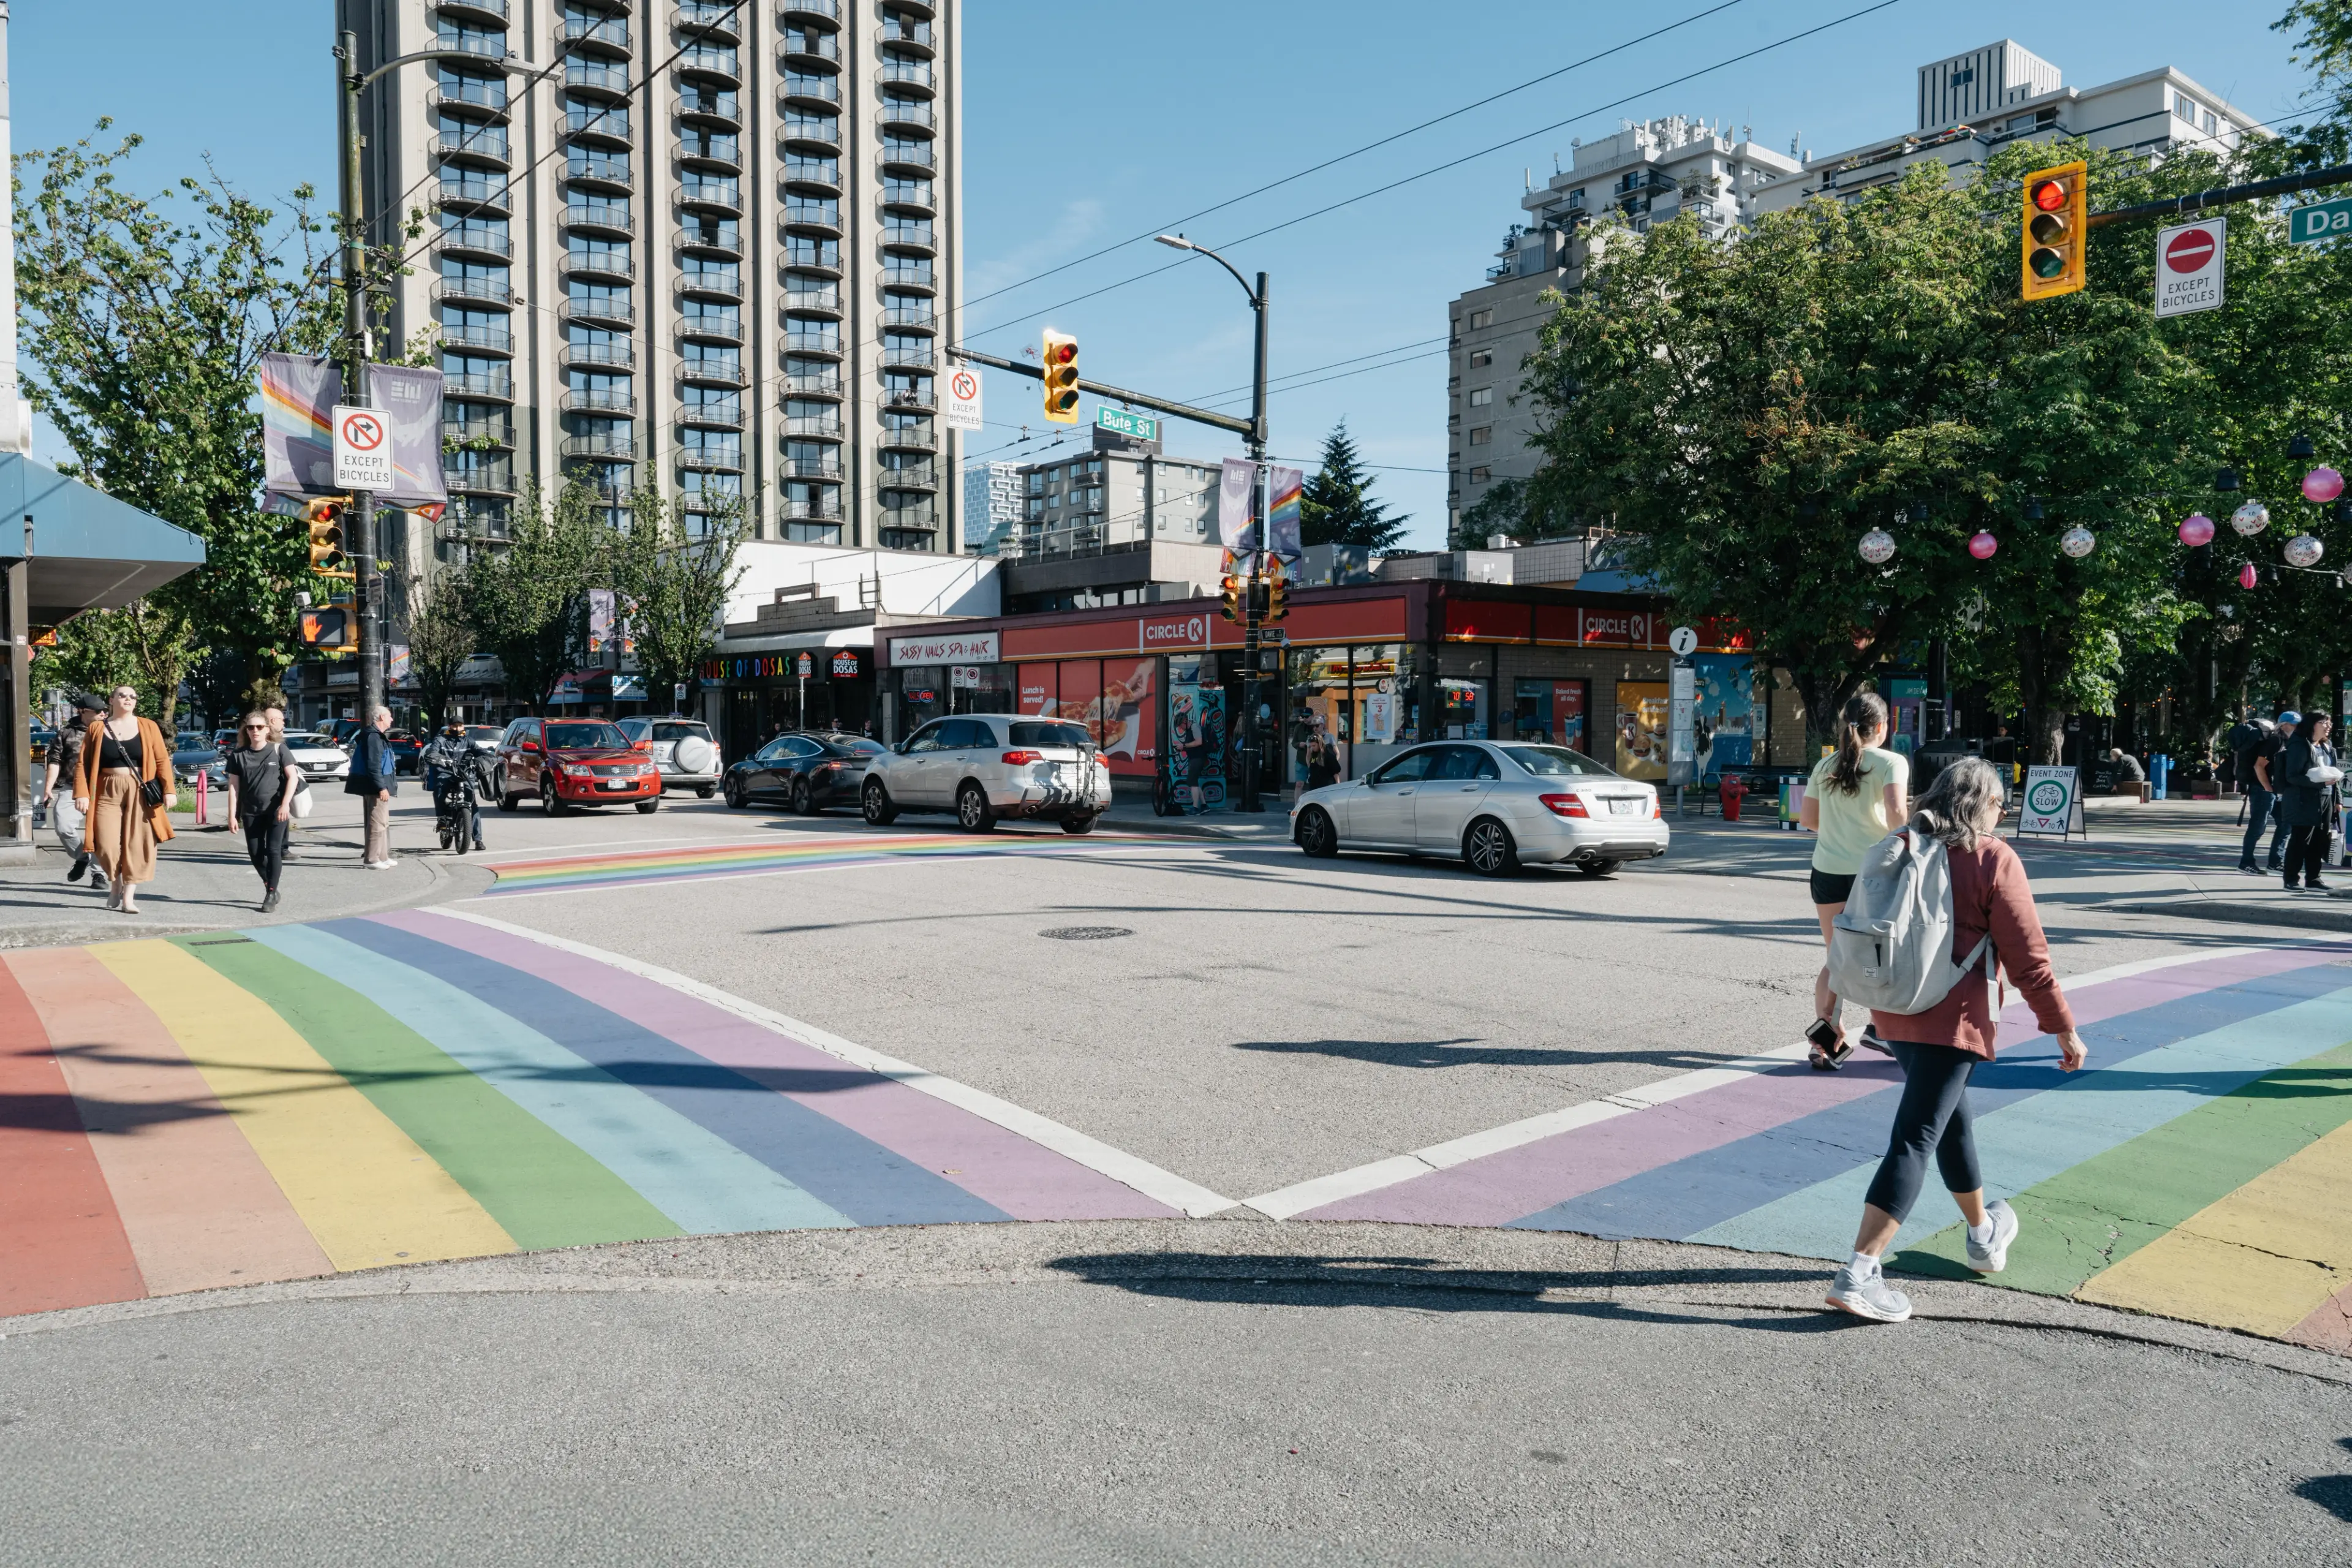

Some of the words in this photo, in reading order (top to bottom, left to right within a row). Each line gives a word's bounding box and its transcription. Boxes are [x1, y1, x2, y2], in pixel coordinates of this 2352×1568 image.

[2168, 277, 2211, 294] EXCEPT
[2163, 290, 2215, 308] BICYCLES
[952, 403, 976, 413] EXCEPT
[949, 414, 980, 425] BICYCLES
[1103, 411, 1131, 432] Bute
[1137, 420, 1150, 436] St
[344, 455, 383, 467] EXCEPT
[340, 470, 389, 483] BICYCLES
[1147, 624, 1185, 640] CIRCLE
[1189, 620, 1202, 641] K
[1586, 617, 1627, 634] CIRCLE
[1632, 617, 1644, 639] K
[900, 645, 922, 660] SASSY
[948, 642, 963, 658] SPA
[699, 661, 730, 679] HOUSE
[737, 659, 748, 677] OF
[755, 657, 790, 676] DOSAS
[833, 665, 858, 674] DOSAS
[1023, 695, 1044, 704] served!
[2030, 769, 2052, 778] EVENT
[2035, 797, 2059, 806] SLOW
